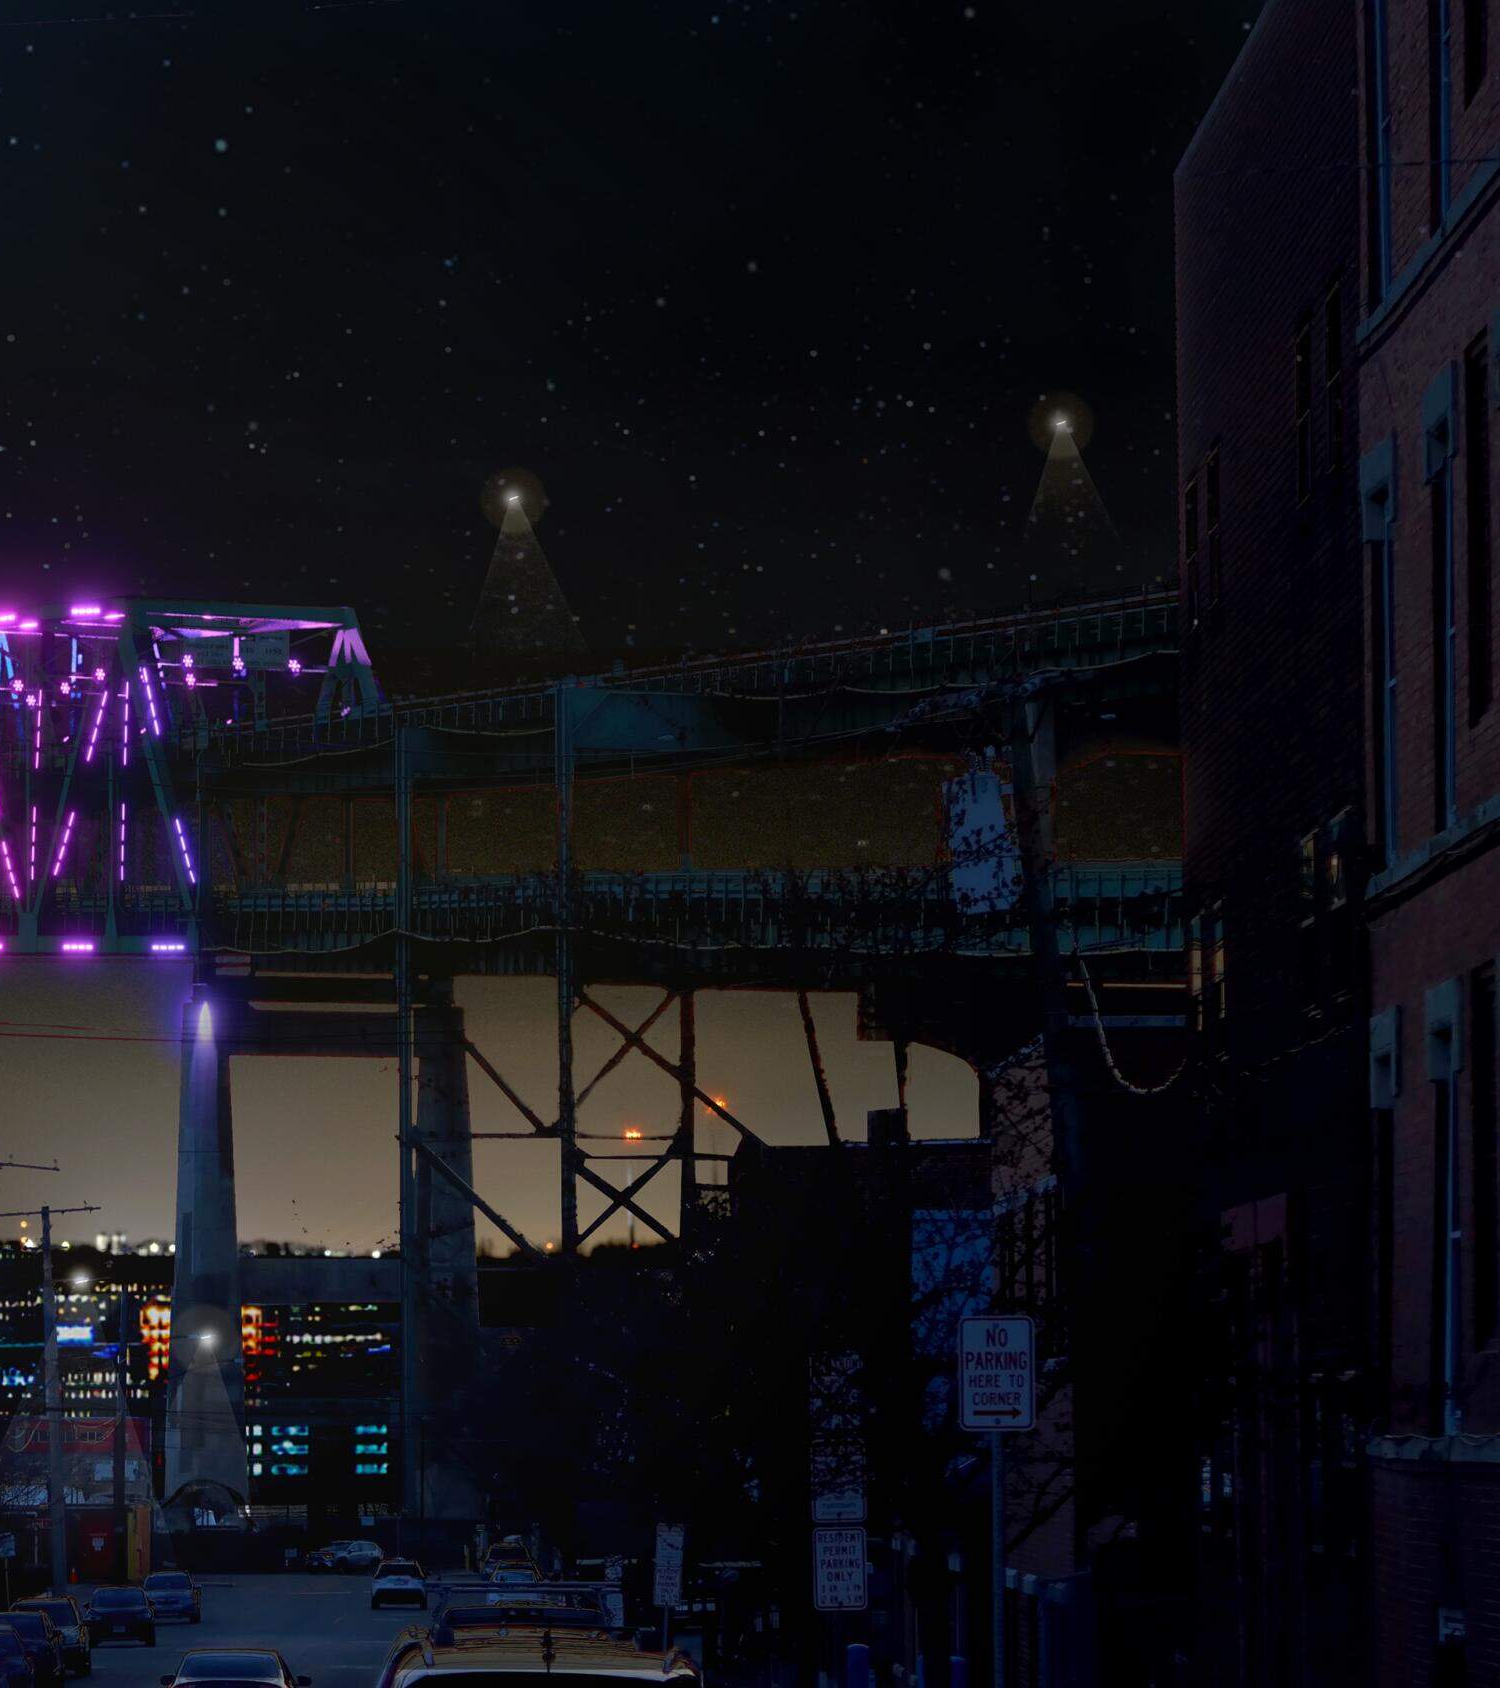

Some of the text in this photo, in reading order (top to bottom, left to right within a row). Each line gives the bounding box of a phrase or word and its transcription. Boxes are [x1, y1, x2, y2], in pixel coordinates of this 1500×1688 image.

[986, 1328, 1008, 1347] NO
[965, 1351, 1028, 1370] PARKING
[968, 1374, 1024, 1388] HERE TO
[972, 1392, 1021, 1406] CORNER
[820, 1559, 860, 1569] PARKING
[827, 1571, 854, 1582] ONLY
